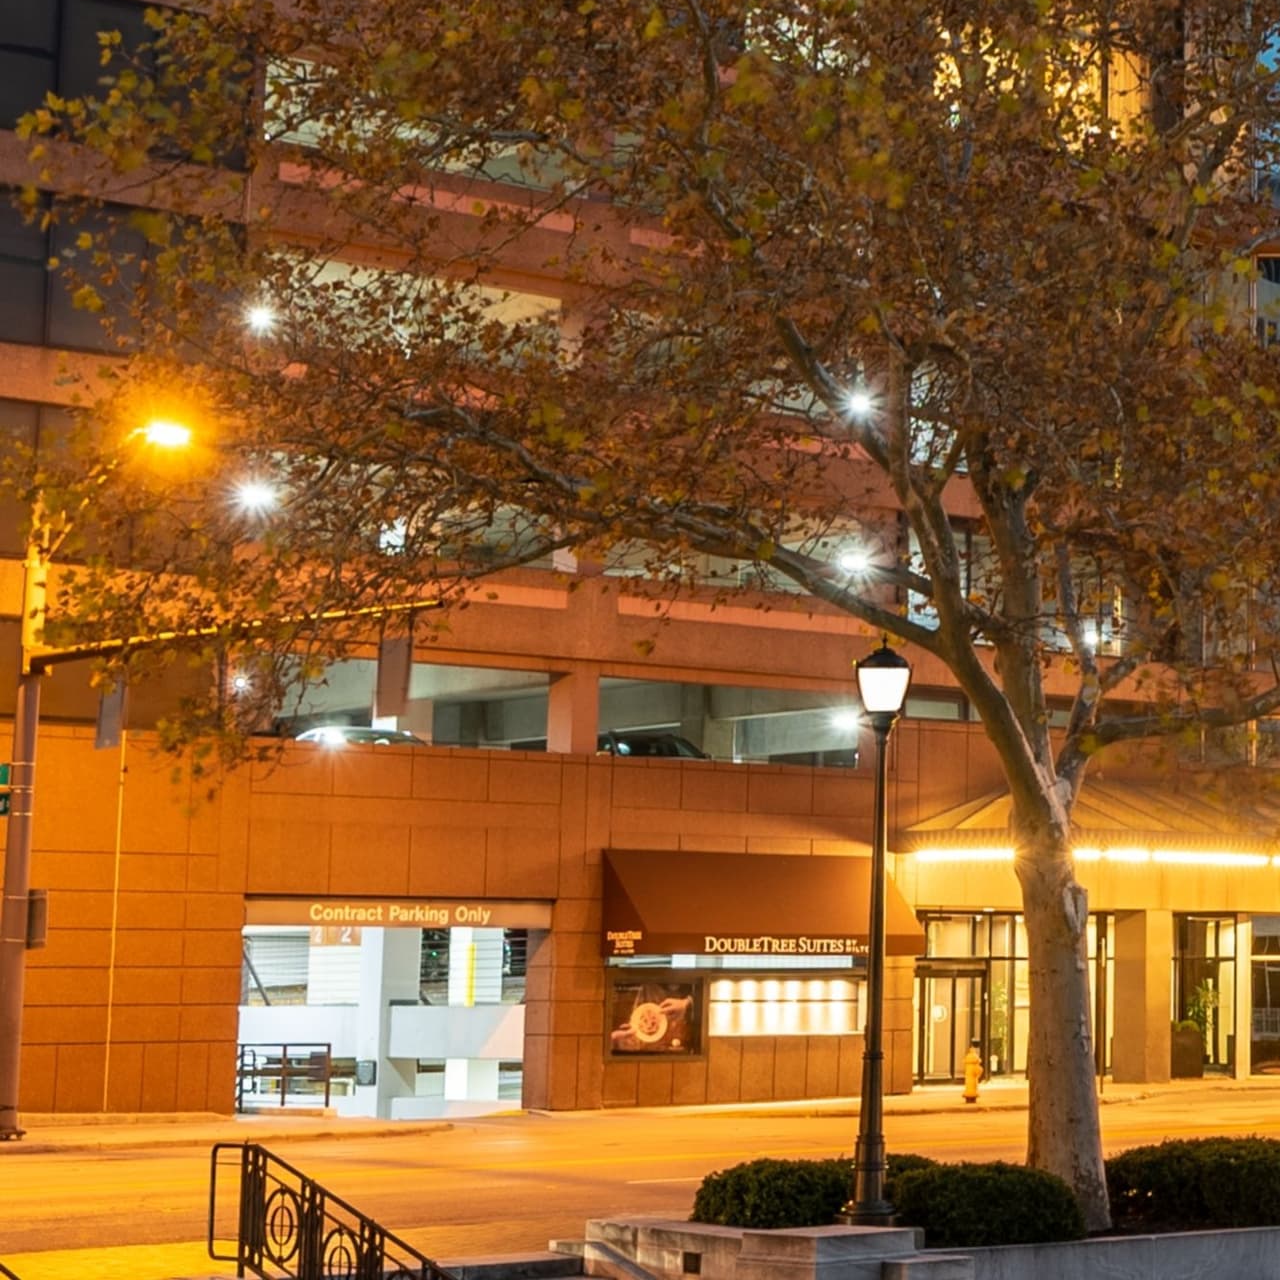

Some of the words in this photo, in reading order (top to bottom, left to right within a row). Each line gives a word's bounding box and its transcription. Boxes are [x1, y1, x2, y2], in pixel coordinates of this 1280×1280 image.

[310, 903, 383, 921] Contract
[389, 905, 449, 924] Parking
[455, 906, 491, 925] Only
[798, 938, 844, 953] SUITES
